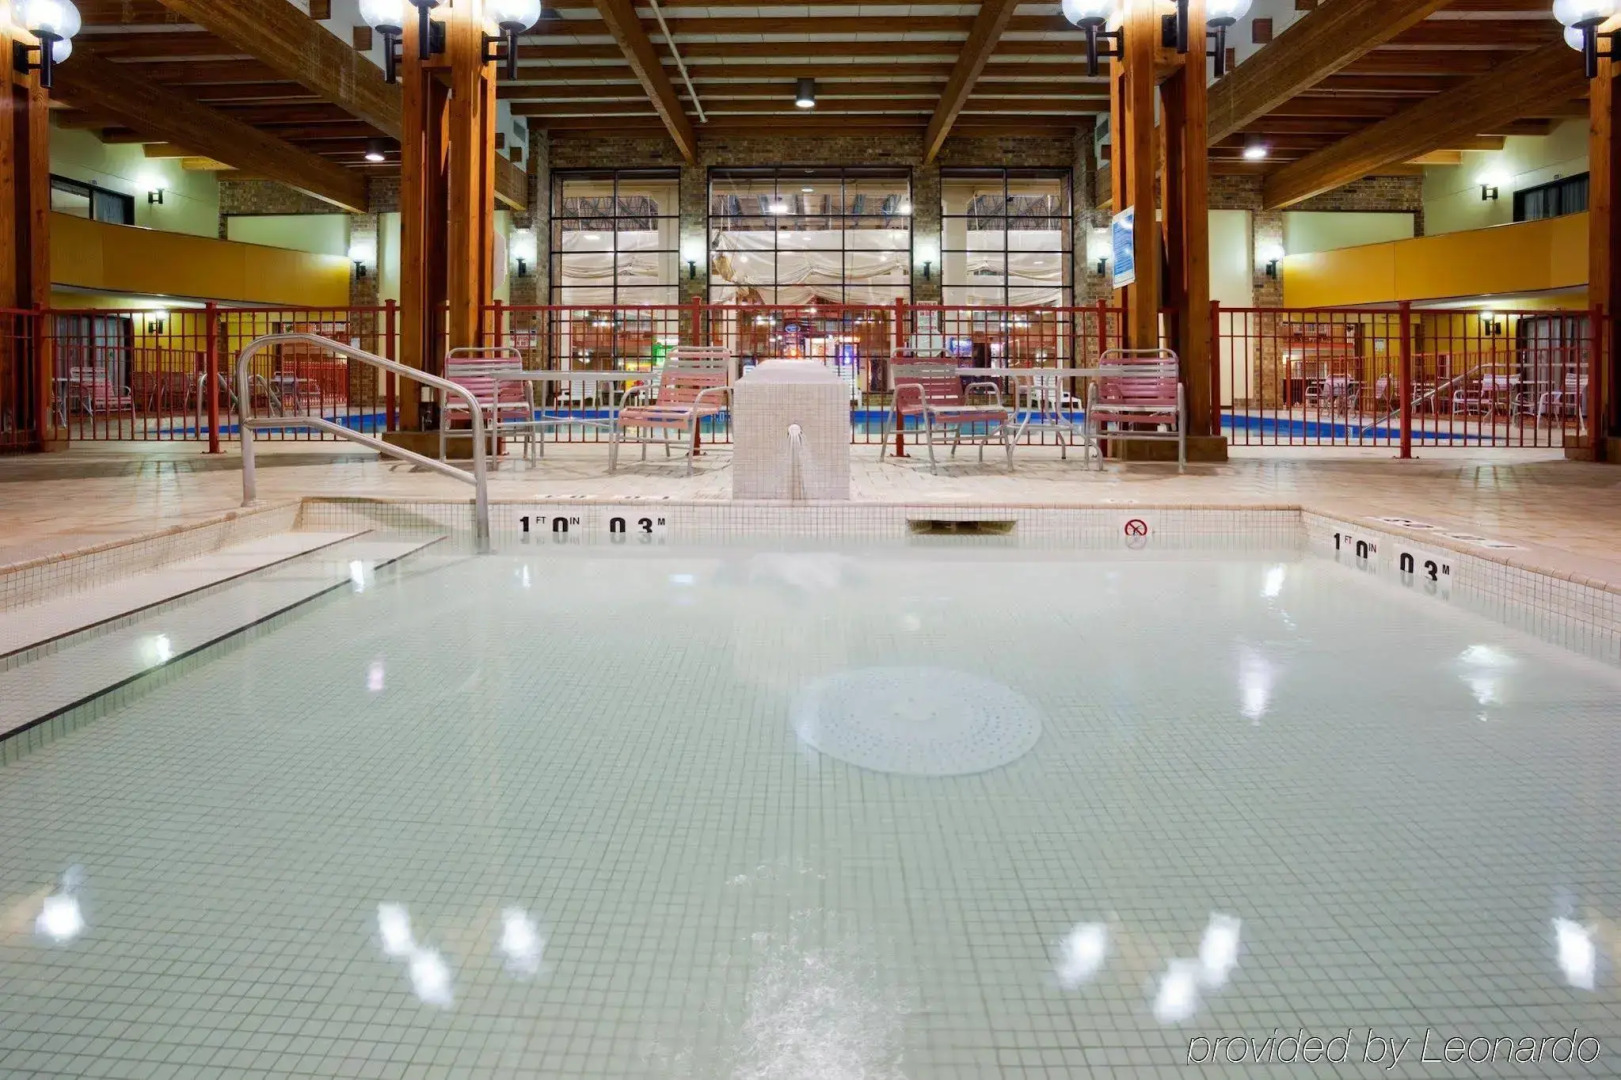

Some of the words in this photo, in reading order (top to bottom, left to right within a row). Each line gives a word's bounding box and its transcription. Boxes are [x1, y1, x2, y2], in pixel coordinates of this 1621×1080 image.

[536, 516, 546, 524] FT
[569, 517, 580, 525] IN
[1344, 535, 1352, 544] FT
[1368, 543, 1377, 553] IN
[1442, 564, 1450, 575] M
